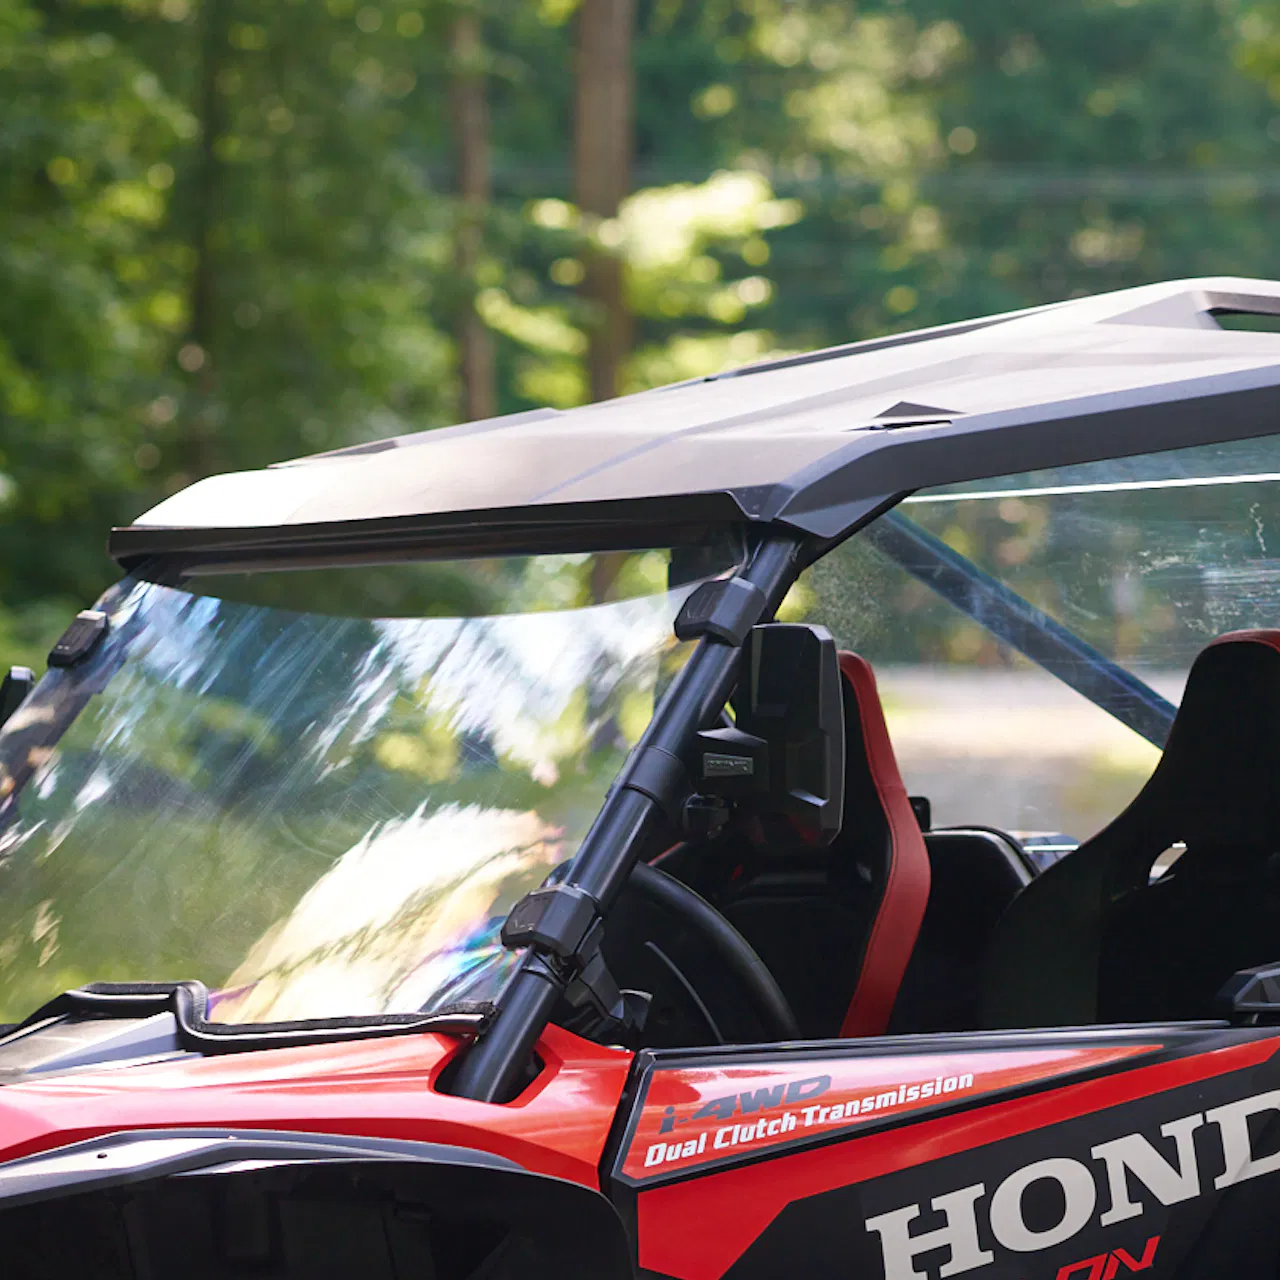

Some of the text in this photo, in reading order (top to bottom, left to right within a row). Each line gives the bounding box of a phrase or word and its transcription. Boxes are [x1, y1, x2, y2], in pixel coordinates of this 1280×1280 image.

[644, 1073, 974, 1168] Dual Clutch Transmission
[659, 1075, 832, 1134] i-4WD
